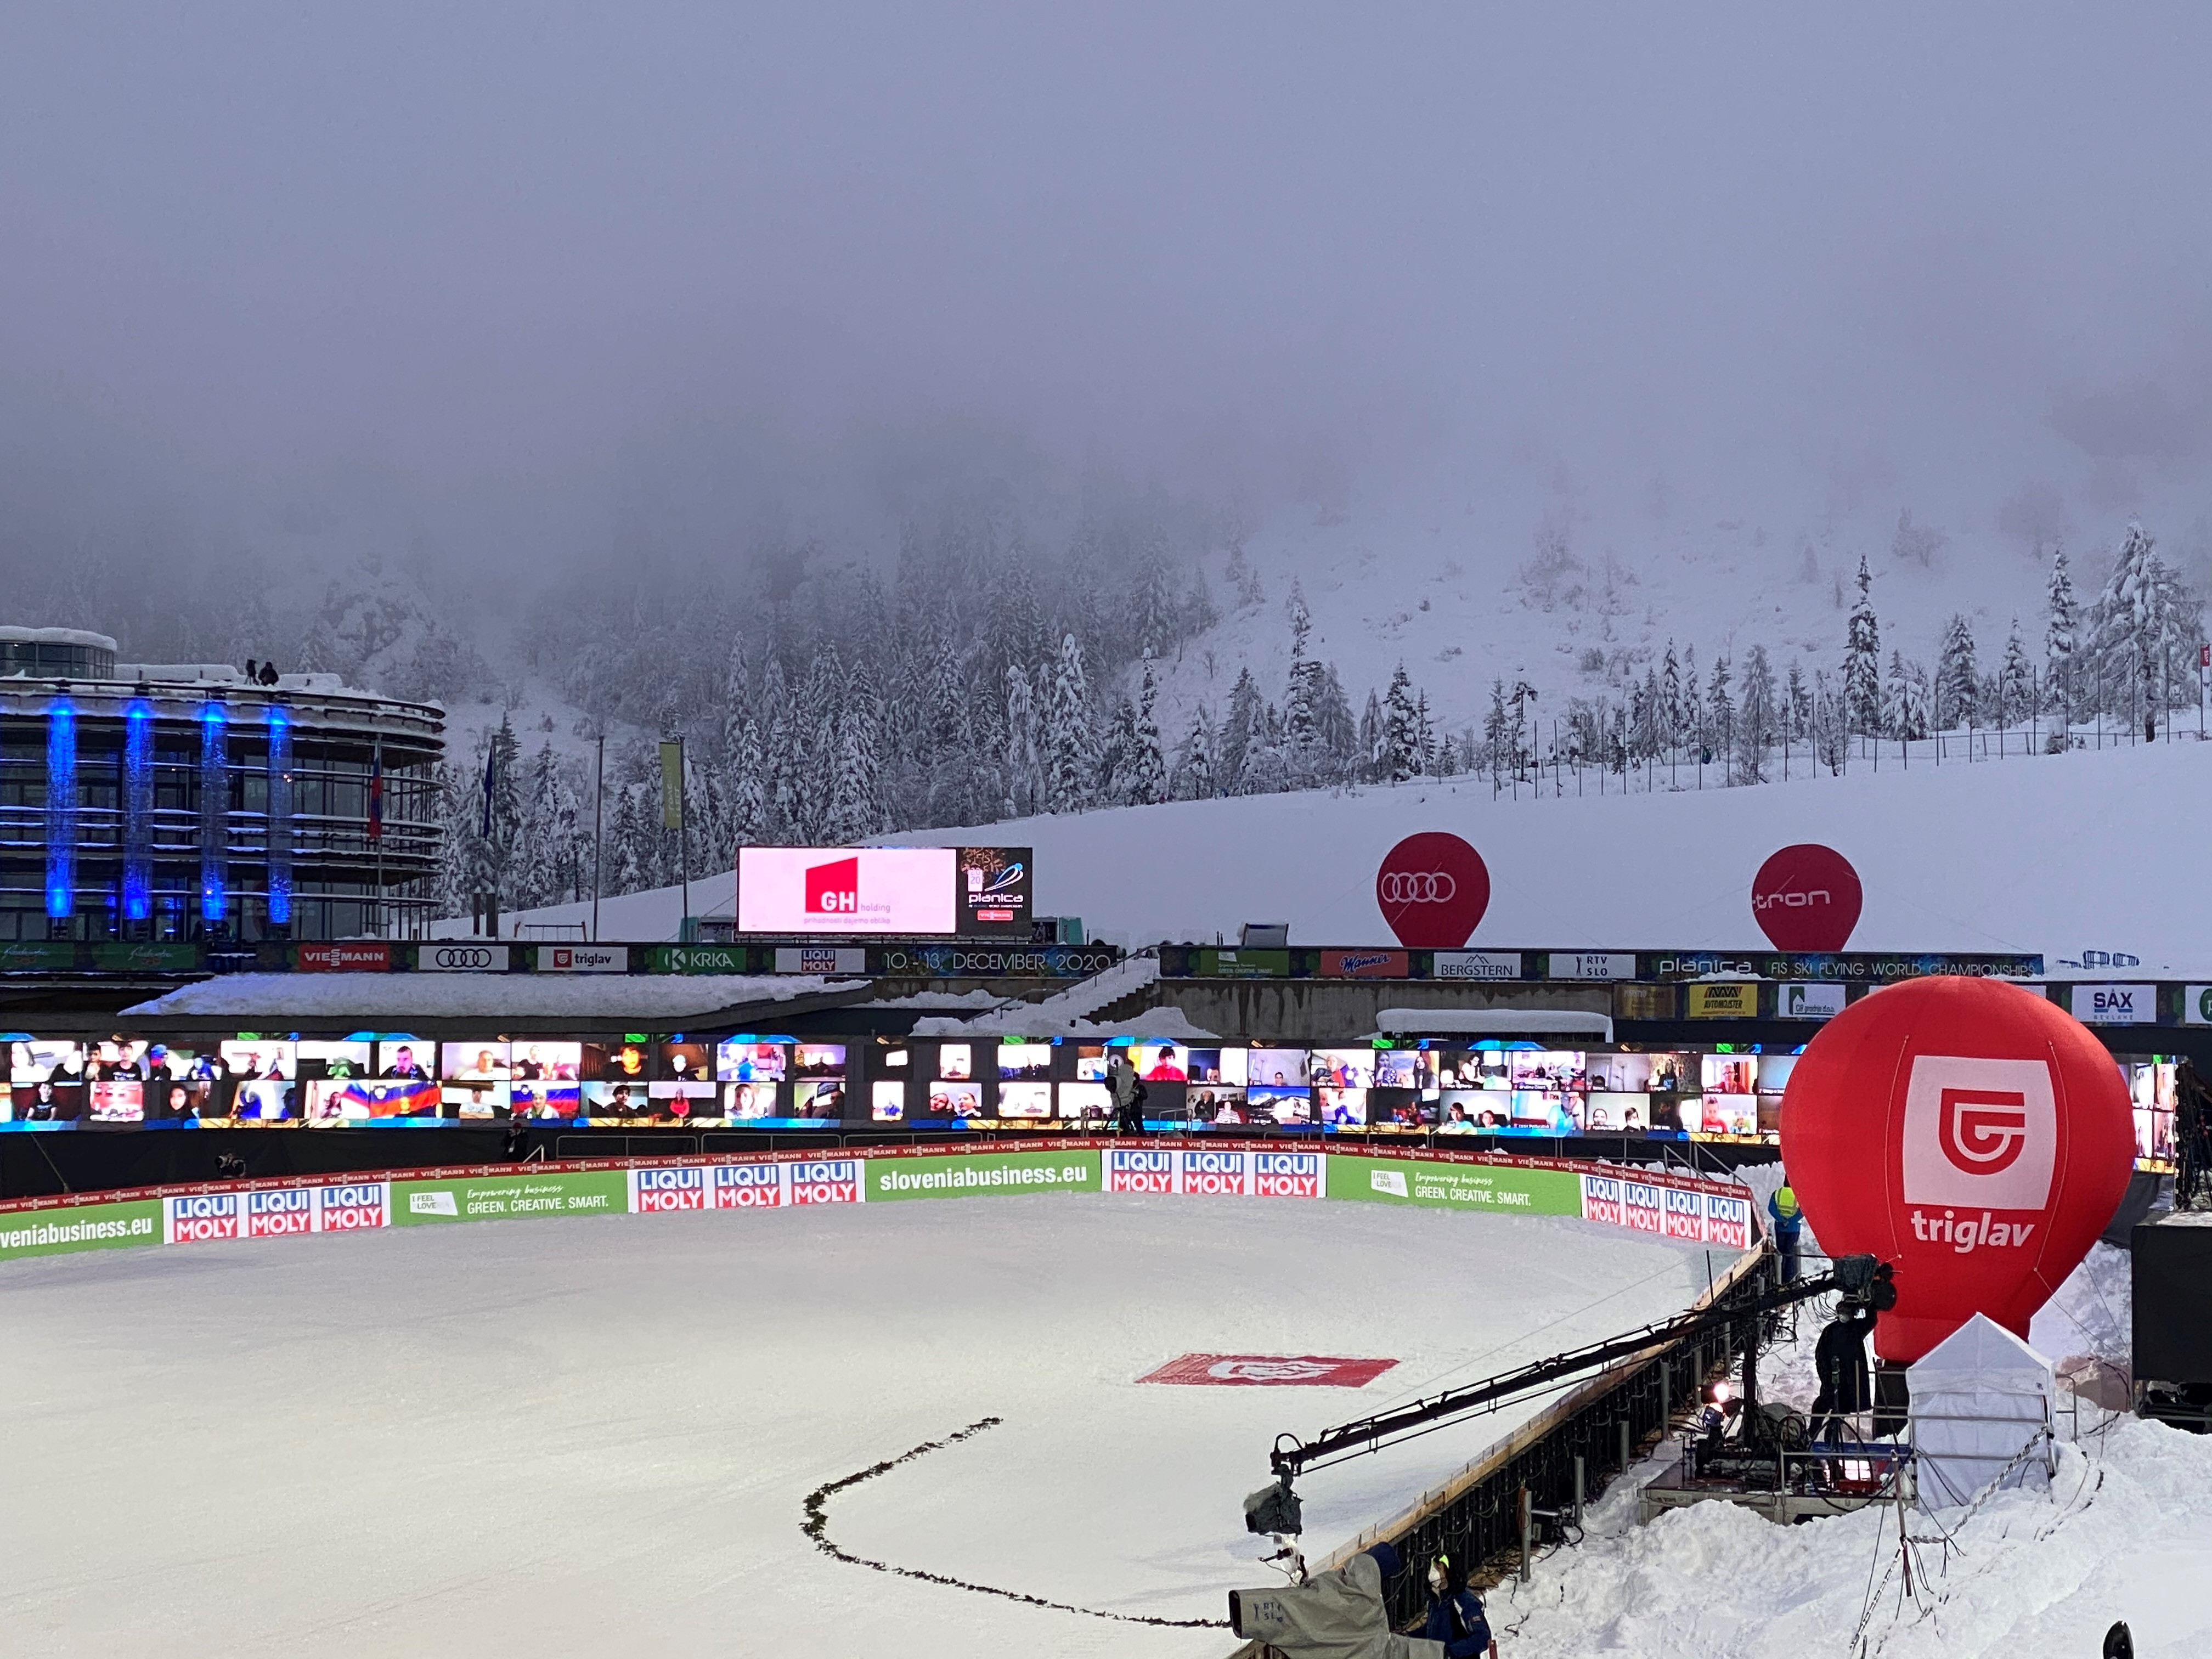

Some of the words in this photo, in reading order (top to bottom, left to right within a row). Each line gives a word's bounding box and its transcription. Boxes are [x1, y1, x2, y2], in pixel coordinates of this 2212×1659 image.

[821, 891, 855, 911] GH
[861, 904, 890, 913] holding
[969, 893, 1023, 904] planica
[305, 949, 383, 966] VIESSMANN
[574, 951, 611, 966] triglav
[690, 952, 734, 967] KRKA
[802, 951, 834, 961] LIQUI
[802, 961, 834, 970] MOLY
[953, 953, 1045, 970] DECEMBER
[1056, 954, 1111, 970] 2020
[1340, 953, 1391, 973] Manner
[1587, 956, 1607, 964] RTV
[1441, 964, 1513, 975] BERGSTERN
[1660, 958, 1752, 974] planica
[1771, 962, 1787, 974] FIS
[1795, 962, 1812, 974] SKI
[1819, 963, 1864, 975] FLYING
[1871, 963, 1921, 975] WORLD
[1928, 964, 2035, 976] CHAMPIONSHIPS
[2094, 989, 2133, 1008] SAX
[1114, 1153, 1169, 1172] LIQUI
[1185, 1154, 1241, 1173] LIQUI
[1258, 1155, 1314, 1176] LIQUI
[641, 1169, 701, 1190] LIQUI
[717, 1166, 777, 1187] LIQUI
[793, 1163, 853, 1183] LIQUI
[880, 1165, 1087, 1191] sloveniabusiness.eu
[1114, 1173, 1171, 1193] MOLY
[1415, 1172, 1458, 1187] Empowering
[1462, 1174, 1493, 1186] business
[467, 1187, 521, 1200] Empowering
[524, 1184, 564, 1194] business
[794, 1183, 855, 1204] MOLY
[1185, 1175, 1243, 1194] MOLY
[1257, 1176, 1317, 1195] MOLY
[1588, 1177, 1618, 1202] LIQUI
[251, 1191, 308, 1214] LIQUI
[324, 1186, 380, 1206] LIQUI
[467, 1201, 506, 1214] GREEN.
[511, 1198, 565, 1212] CREATIVE.
[568, 1195, 609, 1209] SMART.
[641, 1190, 703, 1211] MOLY
[718, 1187, 780, 1207] MOLY
[1415, 1186, 1447, 1200] GREEN.
[1450, 1188, 1494, 1203] CREATIVE.
[1497, 1192, 1531, 1206] SMART.
[1626, 1184, 1658, 1209] LIQUI
[1667, 1190, 1700, 1215] LIQUI
[176, 1196, 235, 1218] LIQUI
[1588, 1200, 1620, 1224] MOLY
[1709, 1197, 1744, 1223] LIQUI
[251, 1212, 310, 1234] MOLY
[324, 1207, 382, 1229] MOLY
[1627, 1207, 1660, 1232] MOLY
[1667, 1214, 1701, 1239] MOLY
[176, 1217, 236, 1241] MOLY
[1709, 1221, 1745, 1246] MOLY
[1910, 1210, 2035, 1252] triglav
